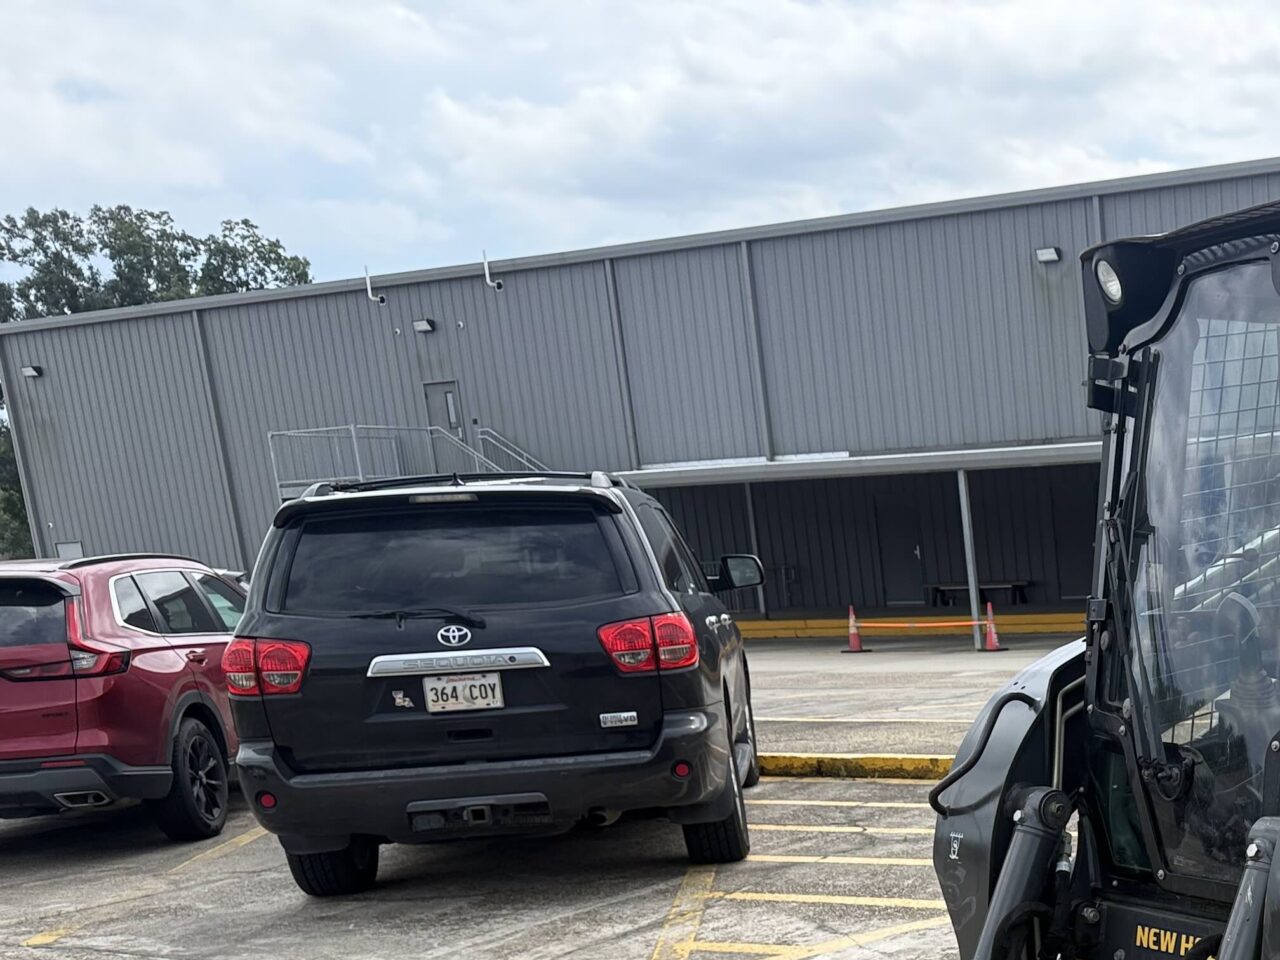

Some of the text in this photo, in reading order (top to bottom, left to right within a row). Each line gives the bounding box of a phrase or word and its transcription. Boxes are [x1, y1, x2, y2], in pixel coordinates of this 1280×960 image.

[402, 655, 508, 670] SEQUOIA
[429, 683, 496, 703] 364 COY
[1135, 924, 1178, 955] NEW
